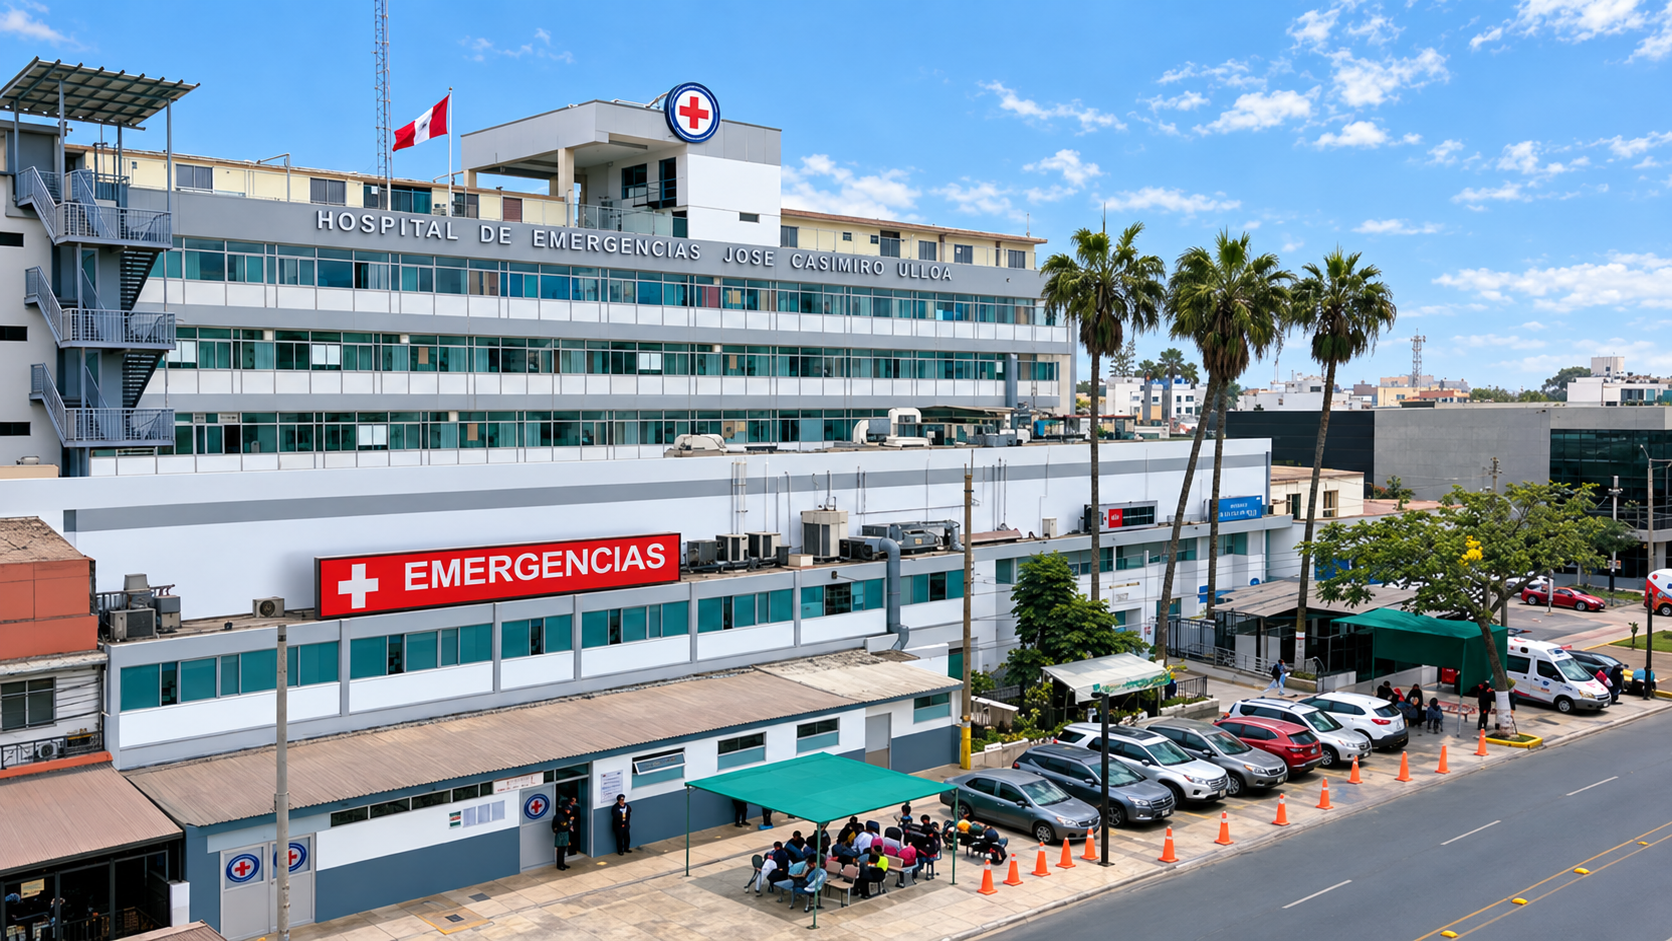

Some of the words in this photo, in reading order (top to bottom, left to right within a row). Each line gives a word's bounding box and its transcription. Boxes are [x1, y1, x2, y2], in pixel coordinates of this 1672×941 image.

[316, 209, 459, 240] HOSPITAL
[480, 224, 512, 245] DE
[532, 228, 701, 260] EMERGENCIAS
[723, 246, 775, 267] JOSE
[791, 253, 885, 275] CASIMIRO
[898, 262, 953, 281] ULLOA
[404, 543, 666, 591] EMERGENCIAS
